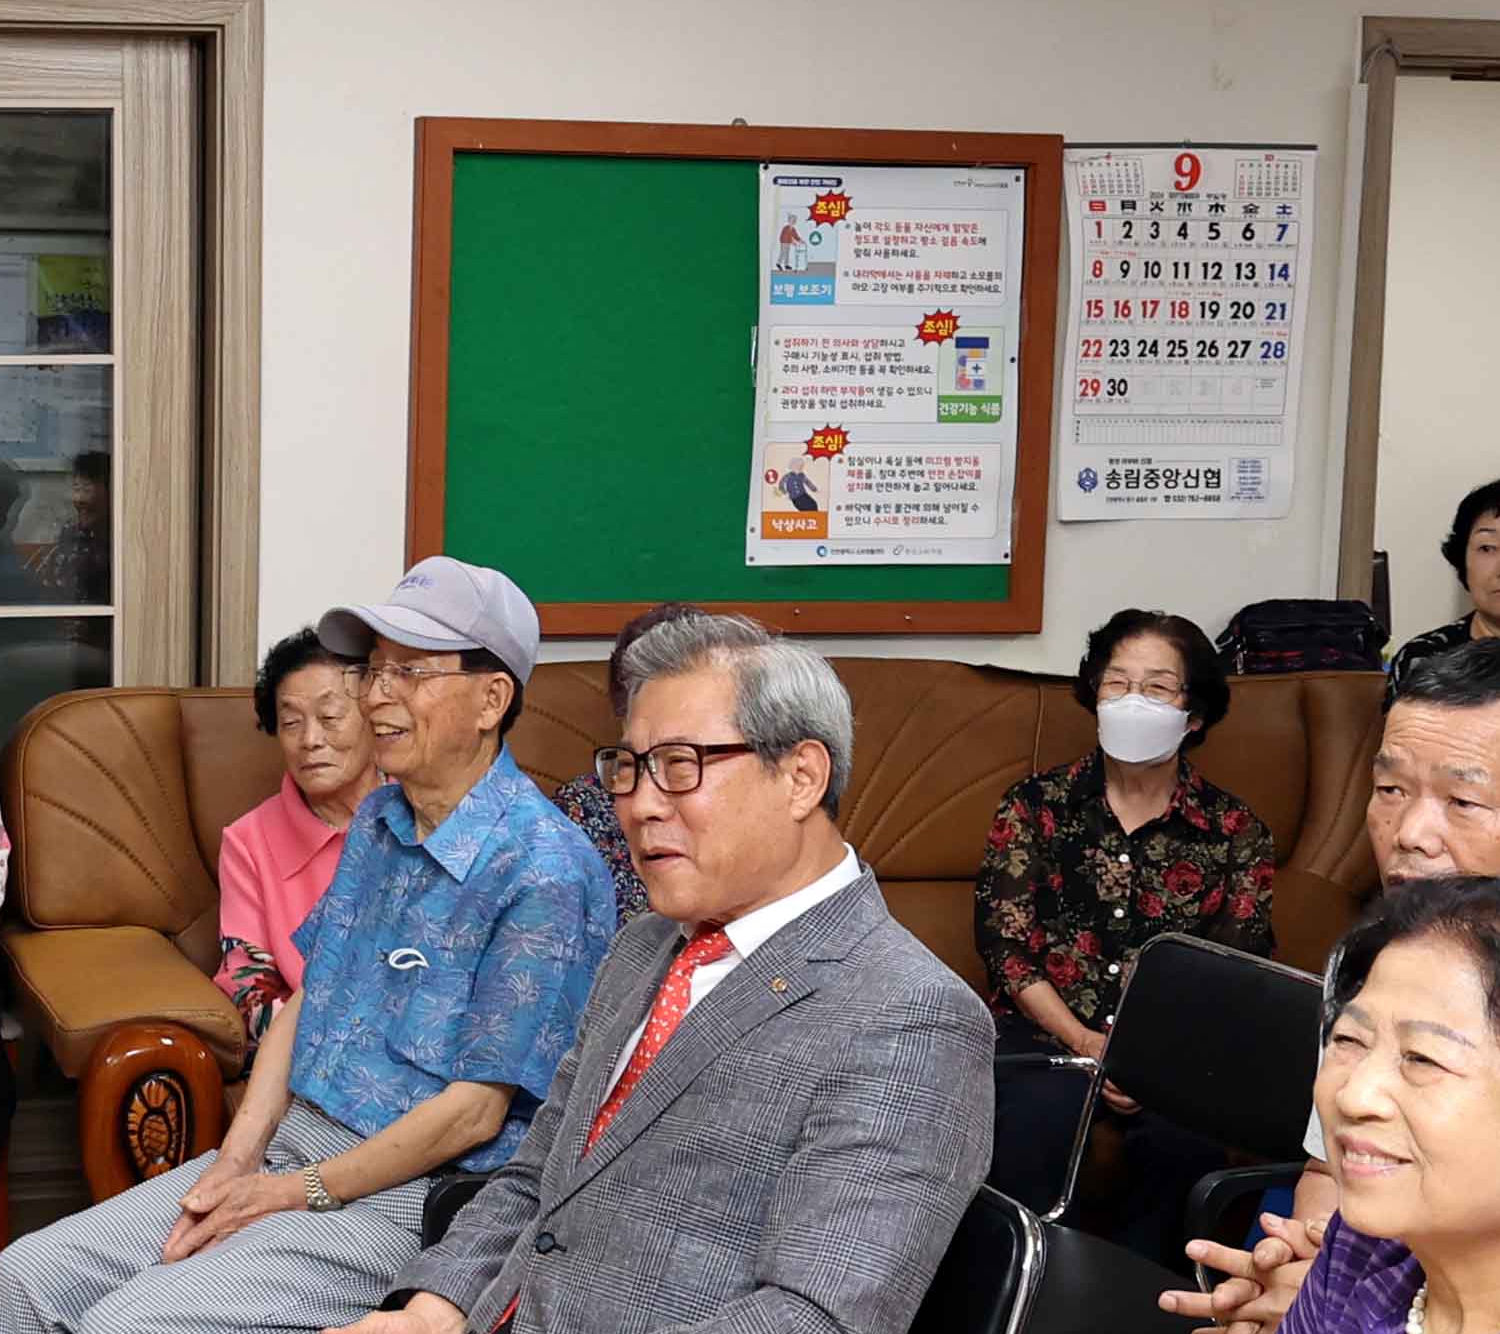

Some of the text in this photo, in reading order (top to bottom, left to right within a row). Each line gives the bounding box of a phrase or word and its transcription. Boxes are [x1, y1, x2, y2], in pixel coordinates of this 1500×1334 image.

[1174, 152, 1201, 192] 9
[815, 200, 845, 217] 조심!
[1150, 201, 1164, 212] 火
[1177, 202, 1193, 213] 水
[1208, 203, 1225, 214] 木
[1242, 203, 1260, 214] 金
[1275, 204, 1292, 215] 土
[1095, 221, 1289, 242] 1 2 3 4 5 6 7
[1092, 260, 1290, 281] 8 9 10 11 12 13 14
[1086, 300, 1287, 320] 15 16 17 18 19 20 21
[923, 319, 953, 336] 조심!
[1081, 339, 1286, 359] 22 23 24 25 26 27 28
[1080, 379, 1128, 397] 29 30
[939, 403, 977, 416] 건강기능
[812, 435, 843, 451] 조심!
[1105, 468, 1221, 490] 송림중앙신협
[771, 519, 818, 533] 낙상사고
